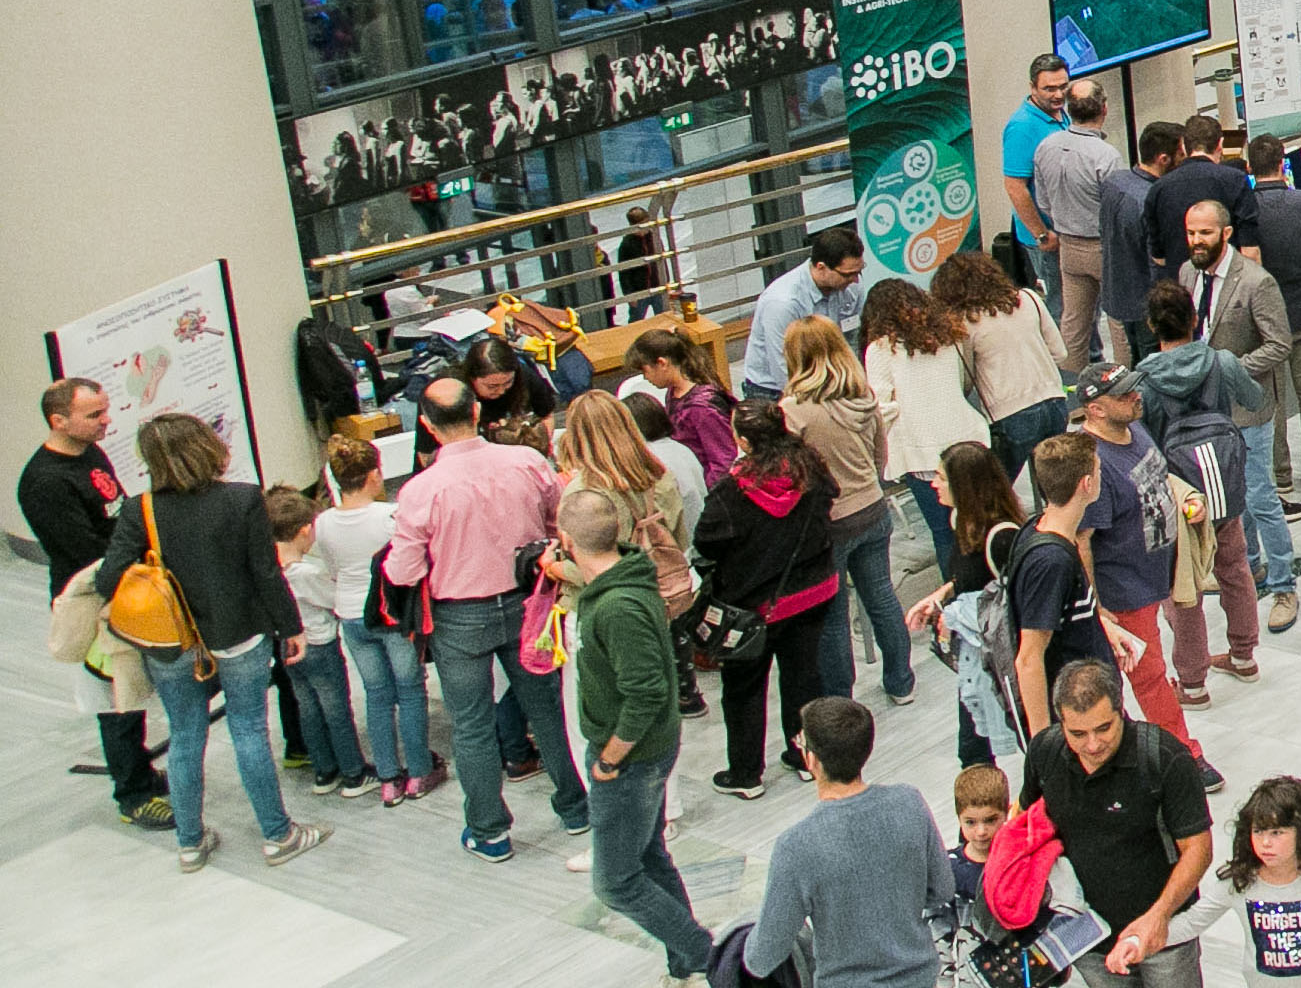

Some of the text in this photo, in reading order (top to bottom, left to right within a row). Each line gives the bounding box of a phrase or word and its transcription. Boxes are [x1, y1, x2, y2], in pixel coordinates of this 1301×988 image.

[856, 5, 864, 14] &
[891, 41, 957, 91] iBO
[1267, 932, 1297, 950] THE
